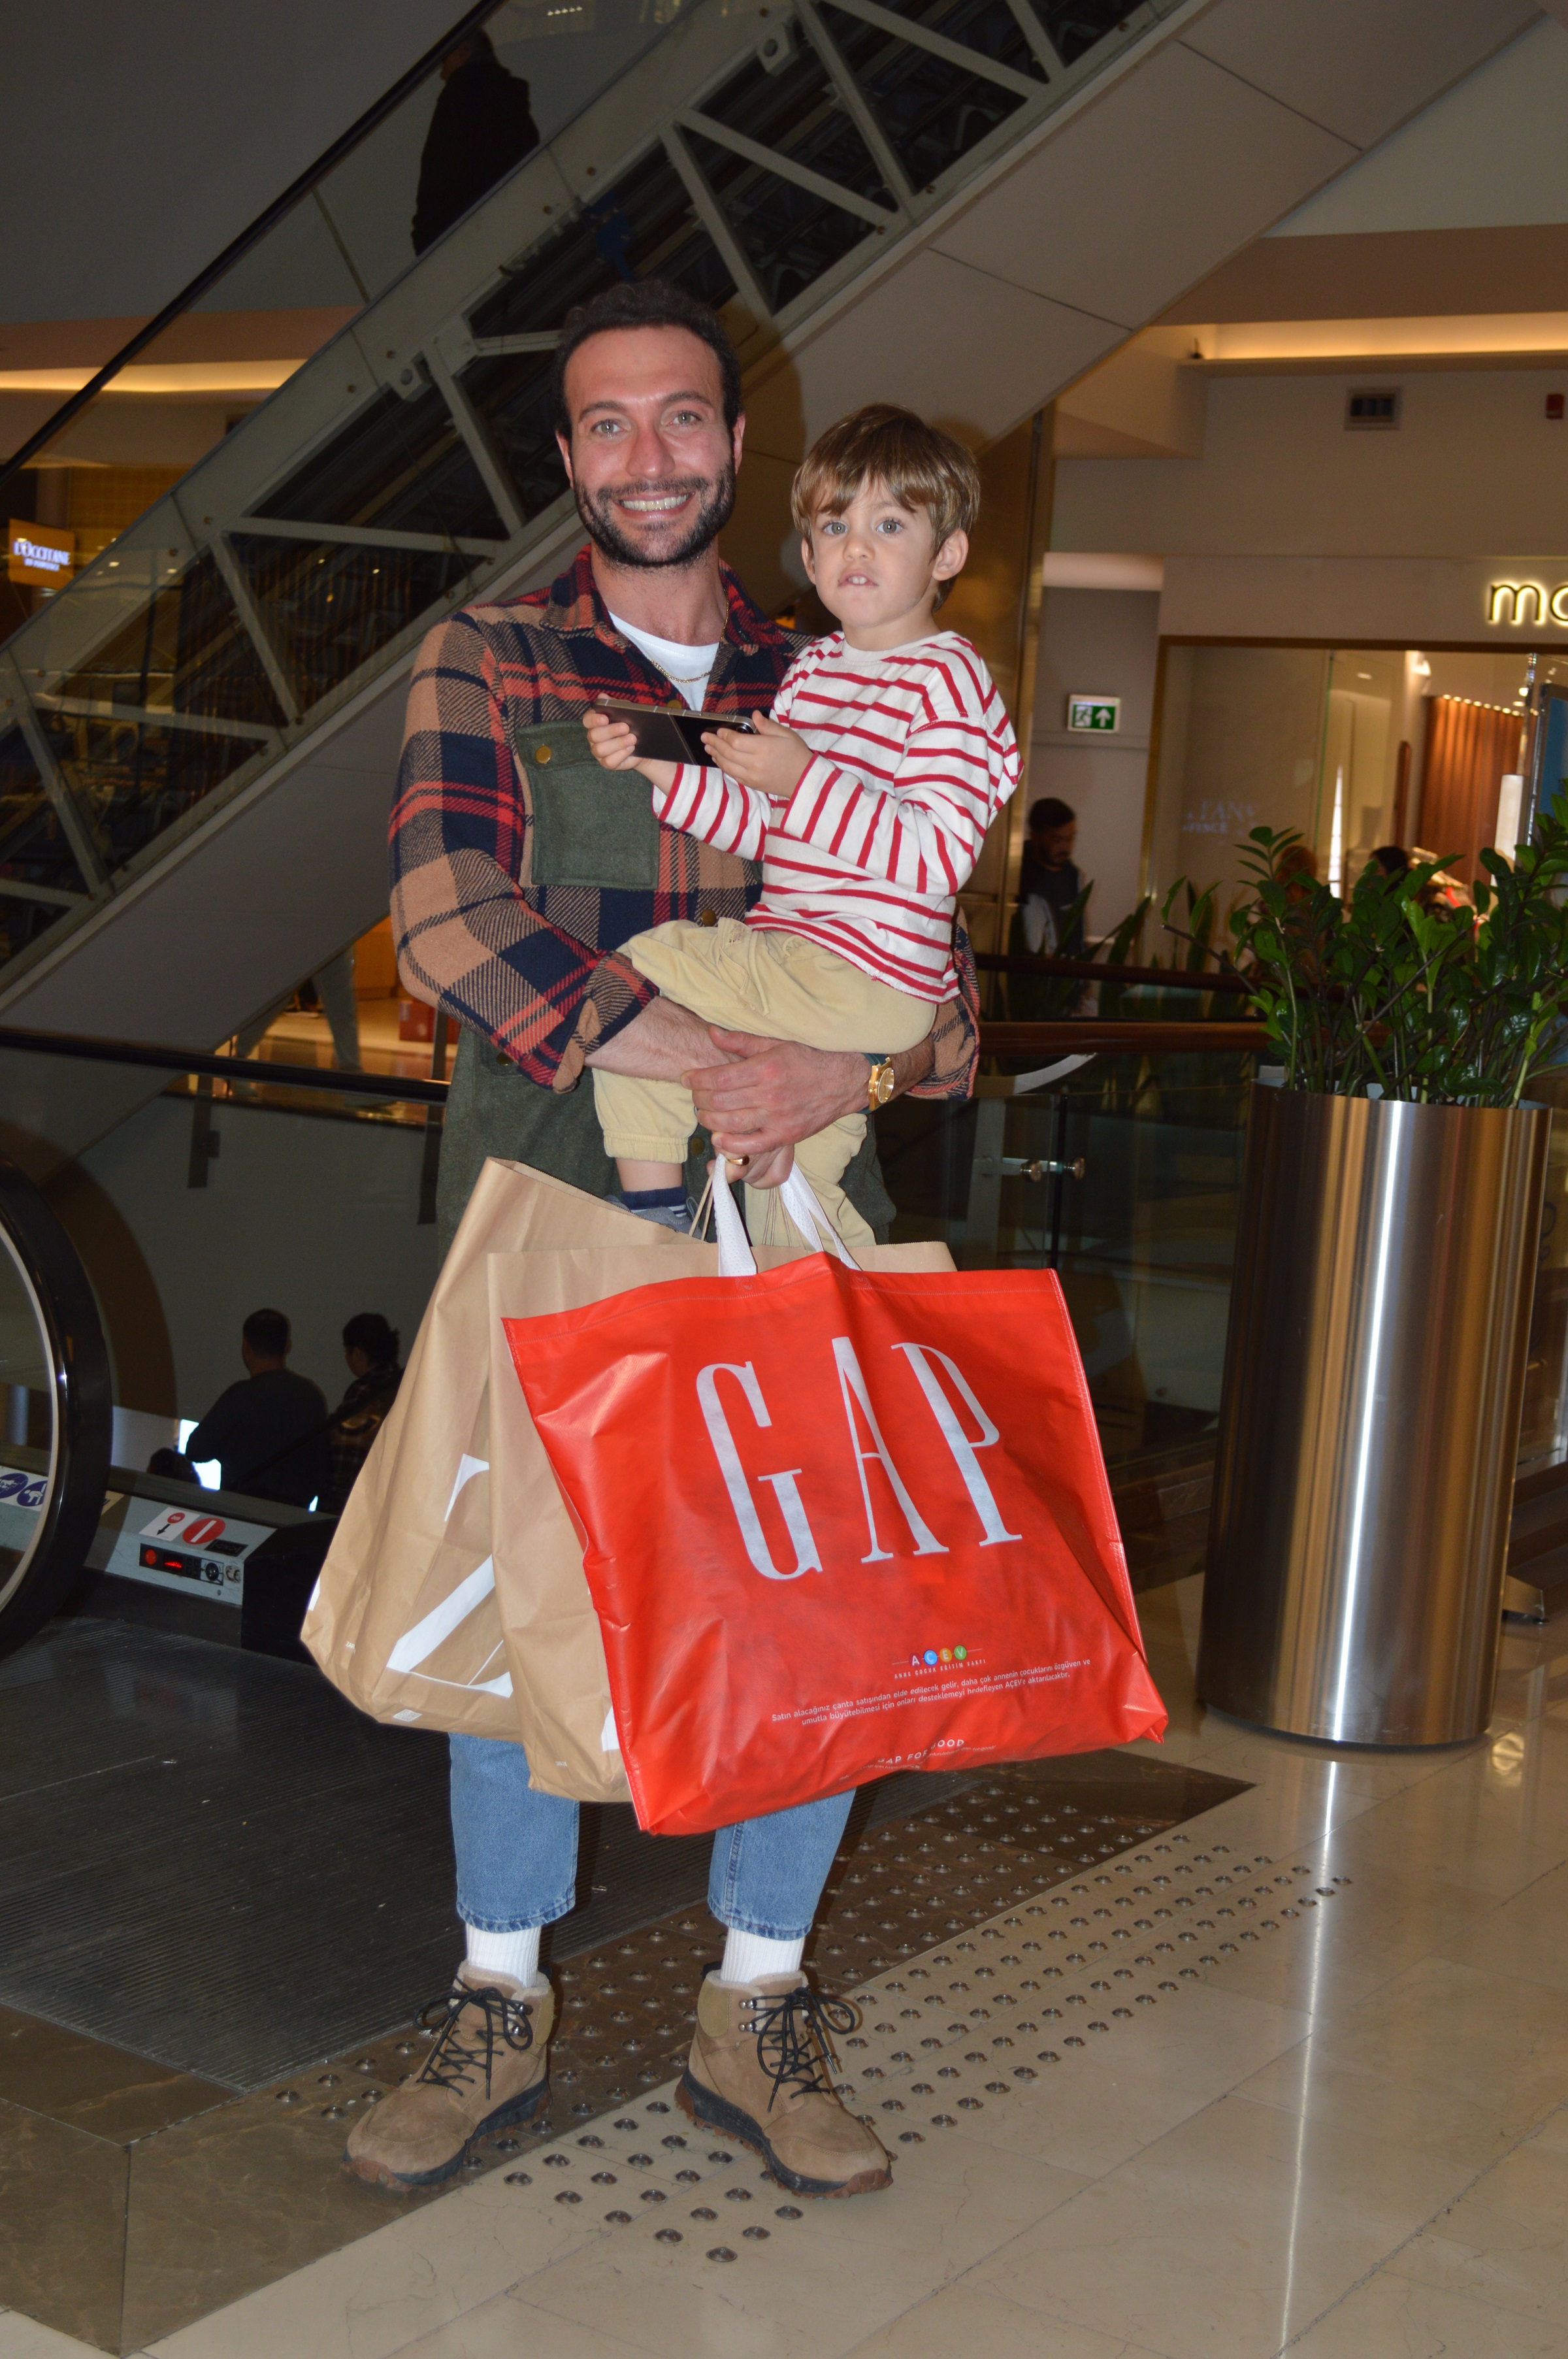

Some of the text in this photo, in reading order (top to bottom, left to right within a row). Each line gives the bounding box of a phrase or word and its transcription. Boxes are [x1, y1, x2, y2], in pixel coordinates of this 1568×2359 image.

[696, 1336, 1022, 1580] GAP
[894, 1671, 911, 1679] ANNE
[915, 1667, 936, 1676] ÇOCUK
[940, 1662, 964, 1671] EĞİTİM
[911, 1646, 964, 1666] AÇEV
[794, 1705, 830, 1718] alacağınız
[832, 1700, 854, 1710] çanta
[856, 1693, 891, 1706] satışından
[893, 1689, 908, 1698] elde
[910, 1684, 939, 1694] edilecek
[941, 1681, 959, 1691] gelir,
[961, 1677, 978, 1687] daha
[980, 1674, 992, 1684] çok
[994, 1669, 1019, 1681] annenin
[1020, 1666, 1053, 1677] çocuklarını
[1054, 1660, 1081, 1671] özgüven
[802, 1672, 1070, 1725] umutla büyütebilmesi için onları desteklemeyi hedefleyen AÇEV'e aktarılacaktır.
